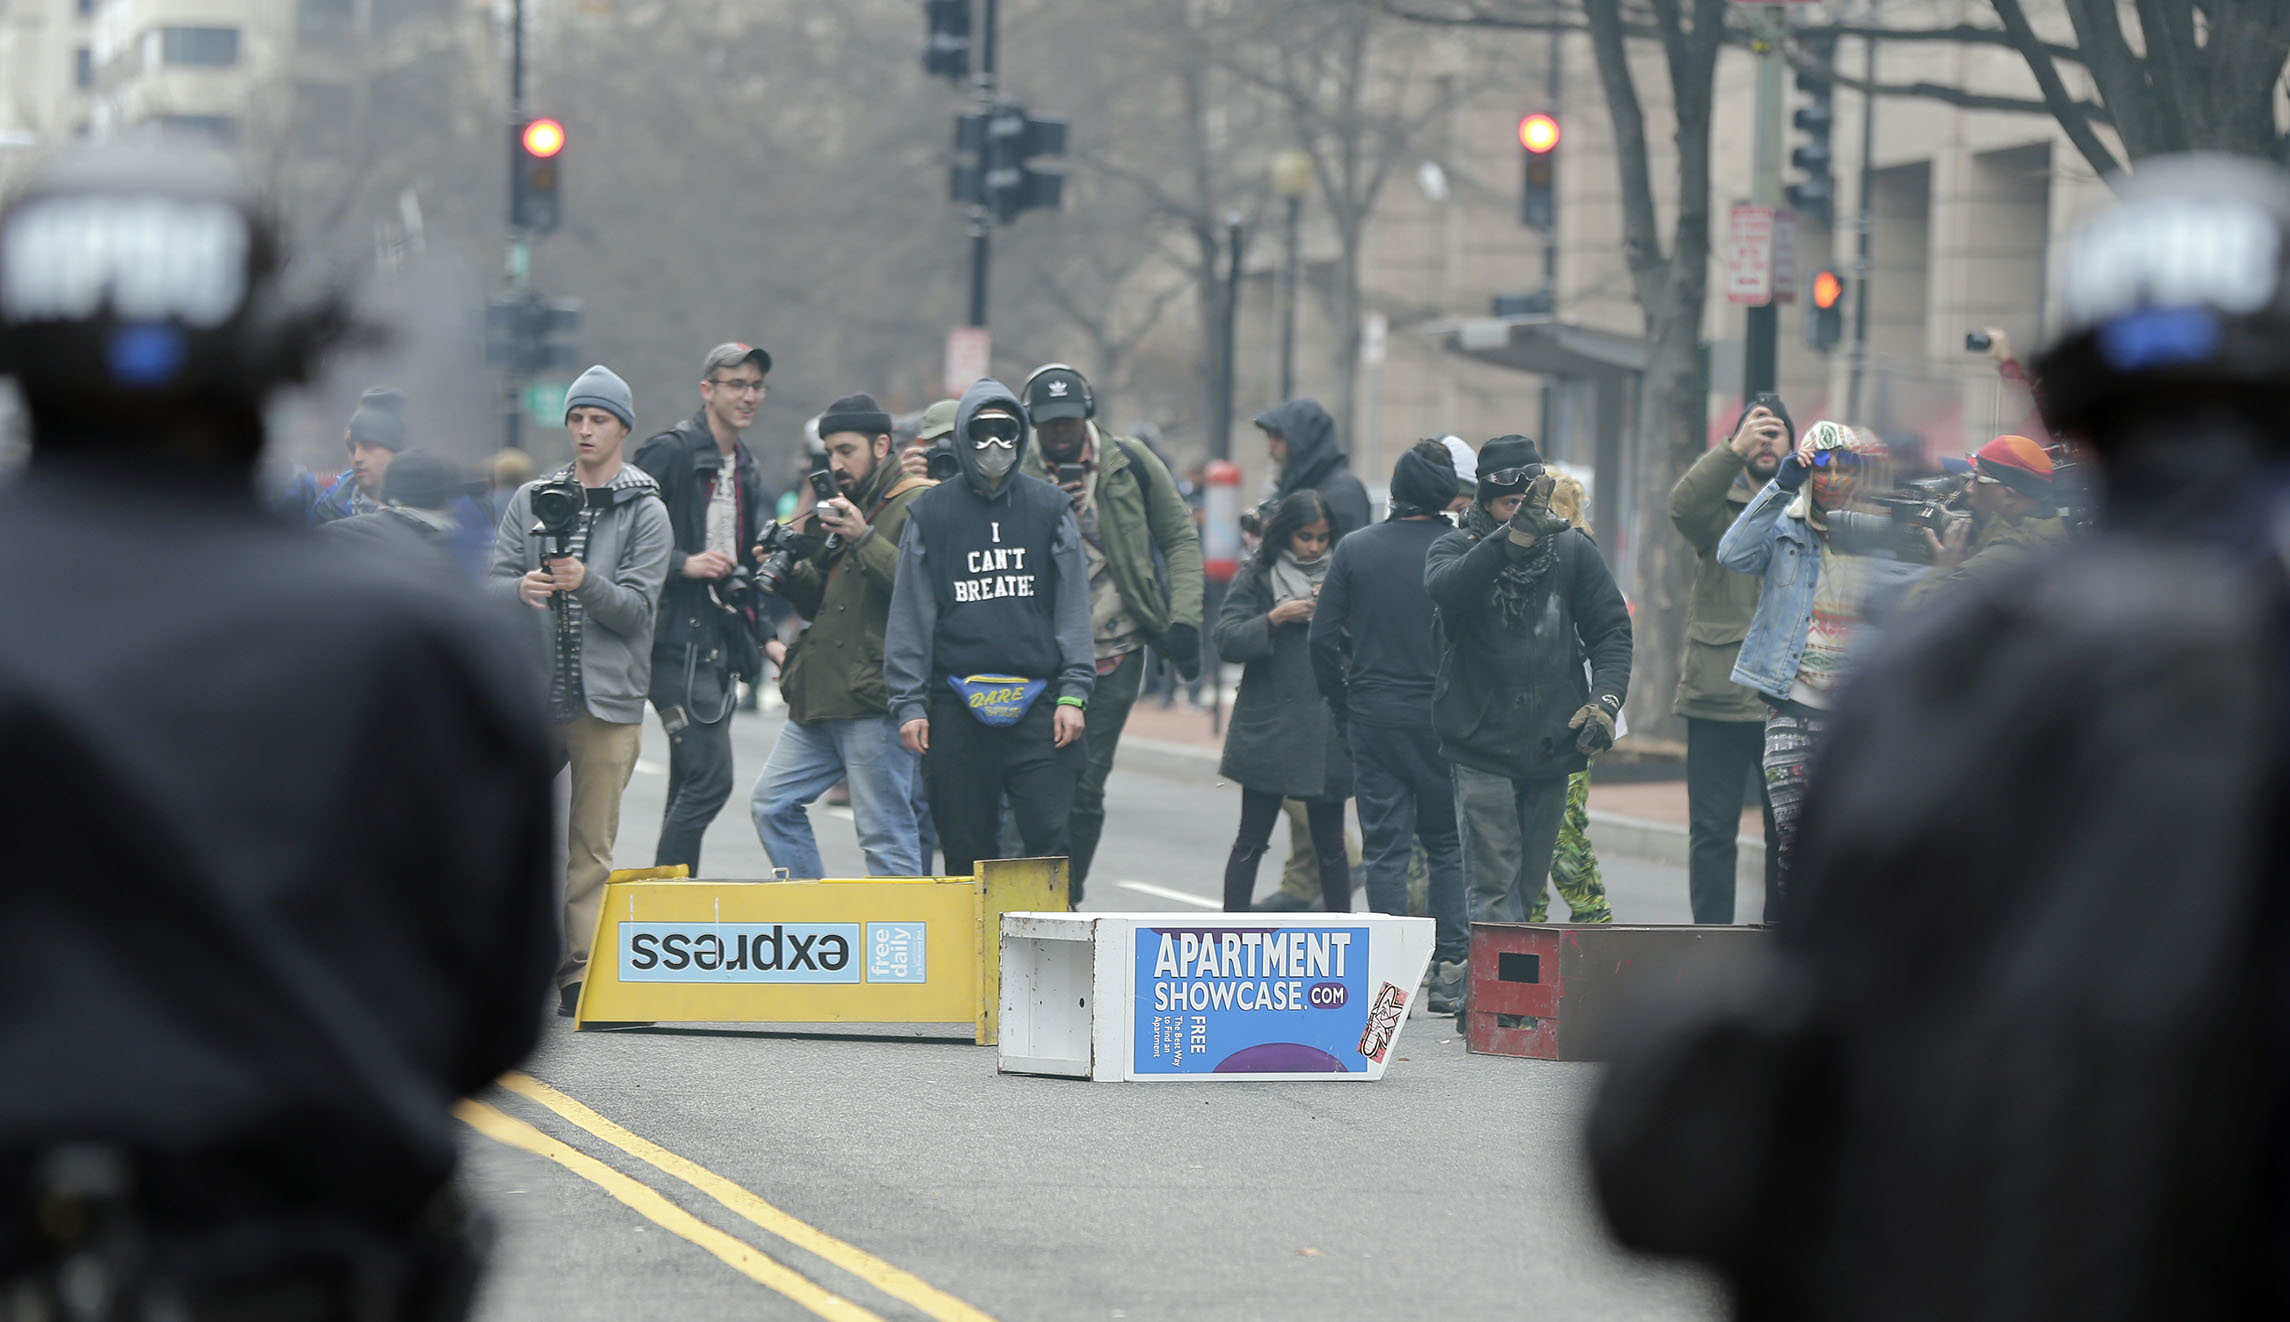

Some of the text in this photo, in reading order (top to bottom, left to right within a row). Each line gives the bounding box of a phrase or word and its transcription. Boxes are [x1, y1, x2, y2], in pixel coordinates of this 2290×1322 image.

[991, 522, 1000, 542] I
[967, 548, 1026, 573] CAN'T
[631, 925, 849, 970] express
[871, 929, 890, 976] free
[890, 928, 912, 977] daily
[1154, 932, 1351, 977] APARTMENT
[1152, 1016, 1162, 1058] Apartment
[1164, 1016, 1172, 1053] to Find an
[1172, 1016, 1183, 1067] The Best Way
[1190, 1016, 1206, 1054] FREE
